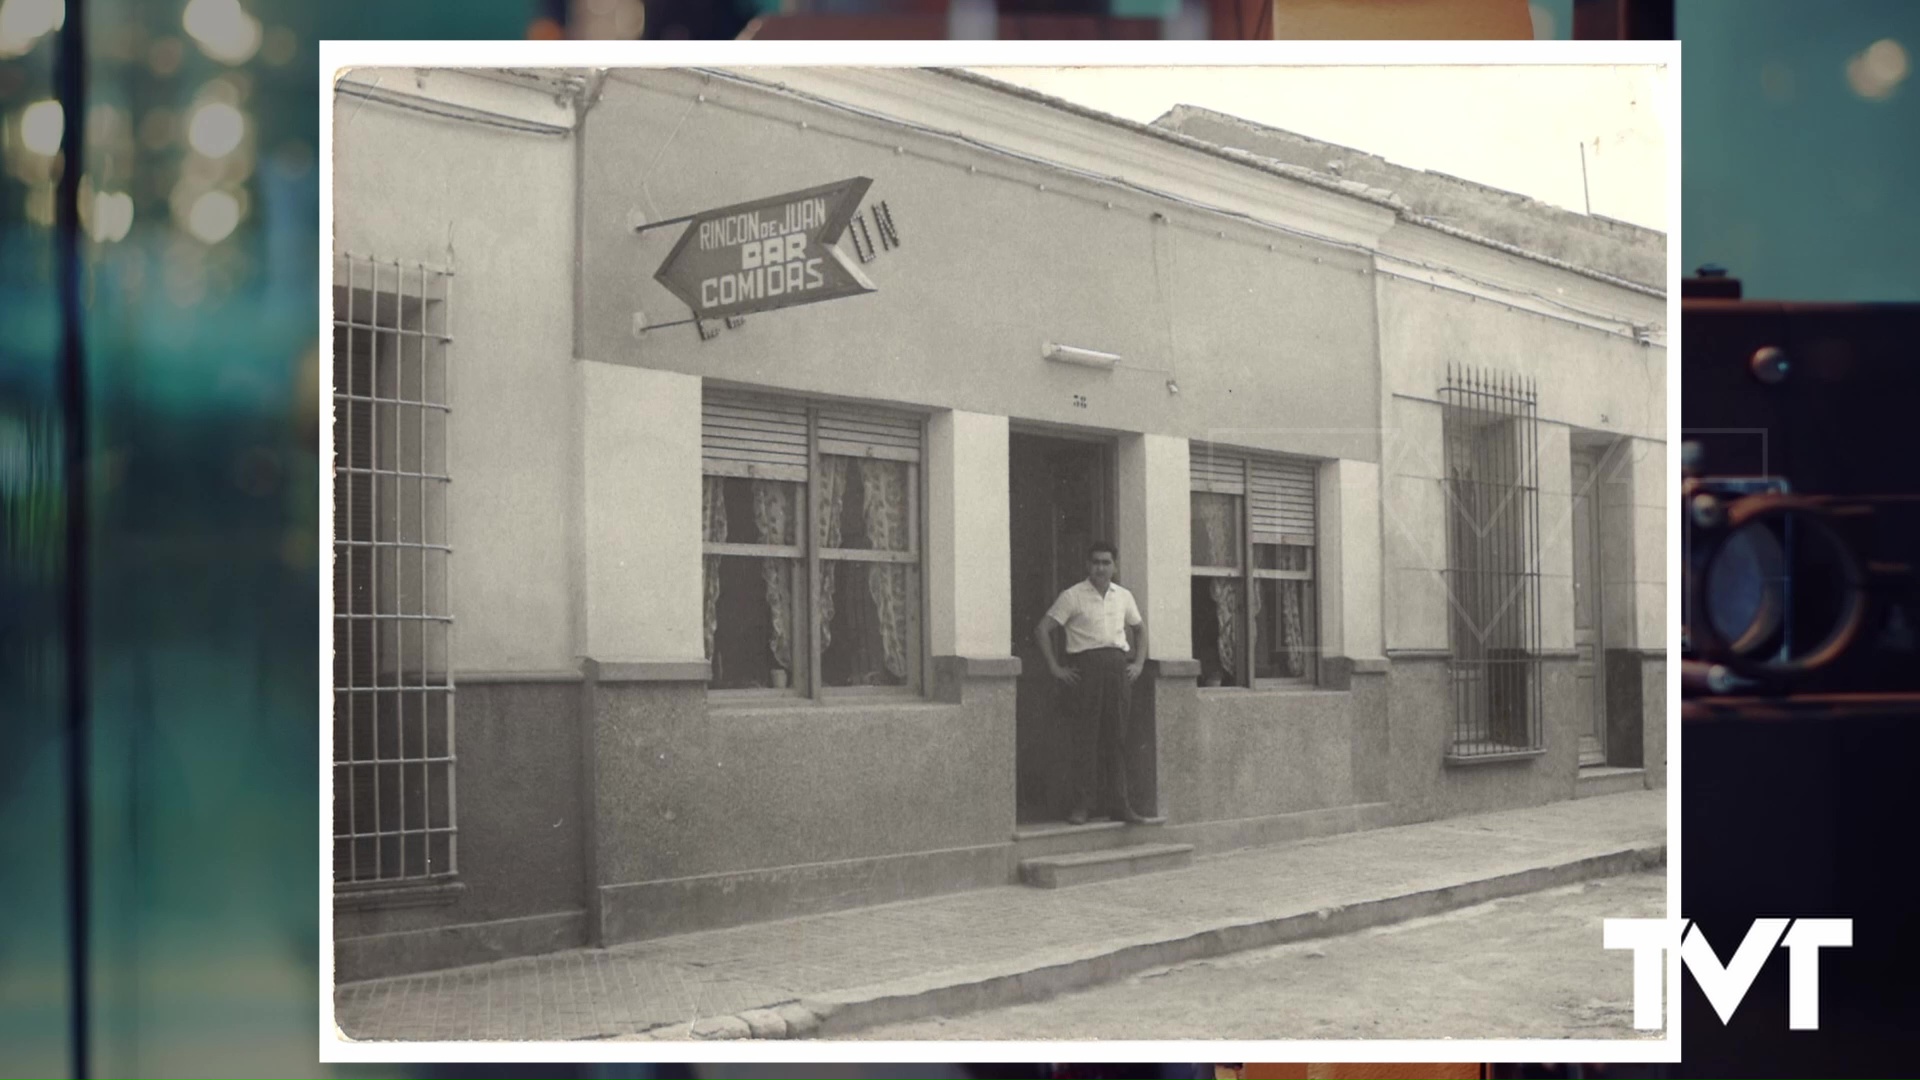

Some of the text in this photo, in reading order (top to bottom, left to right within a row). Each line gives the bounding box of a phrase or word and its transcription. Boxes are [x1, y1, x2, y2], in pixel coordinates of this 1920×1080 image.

[701, 197, 826, 251] RINCON DE JUAN
[741, 232, 807, 270] BAR
[702, 257, 823, 308] COMIDAS
